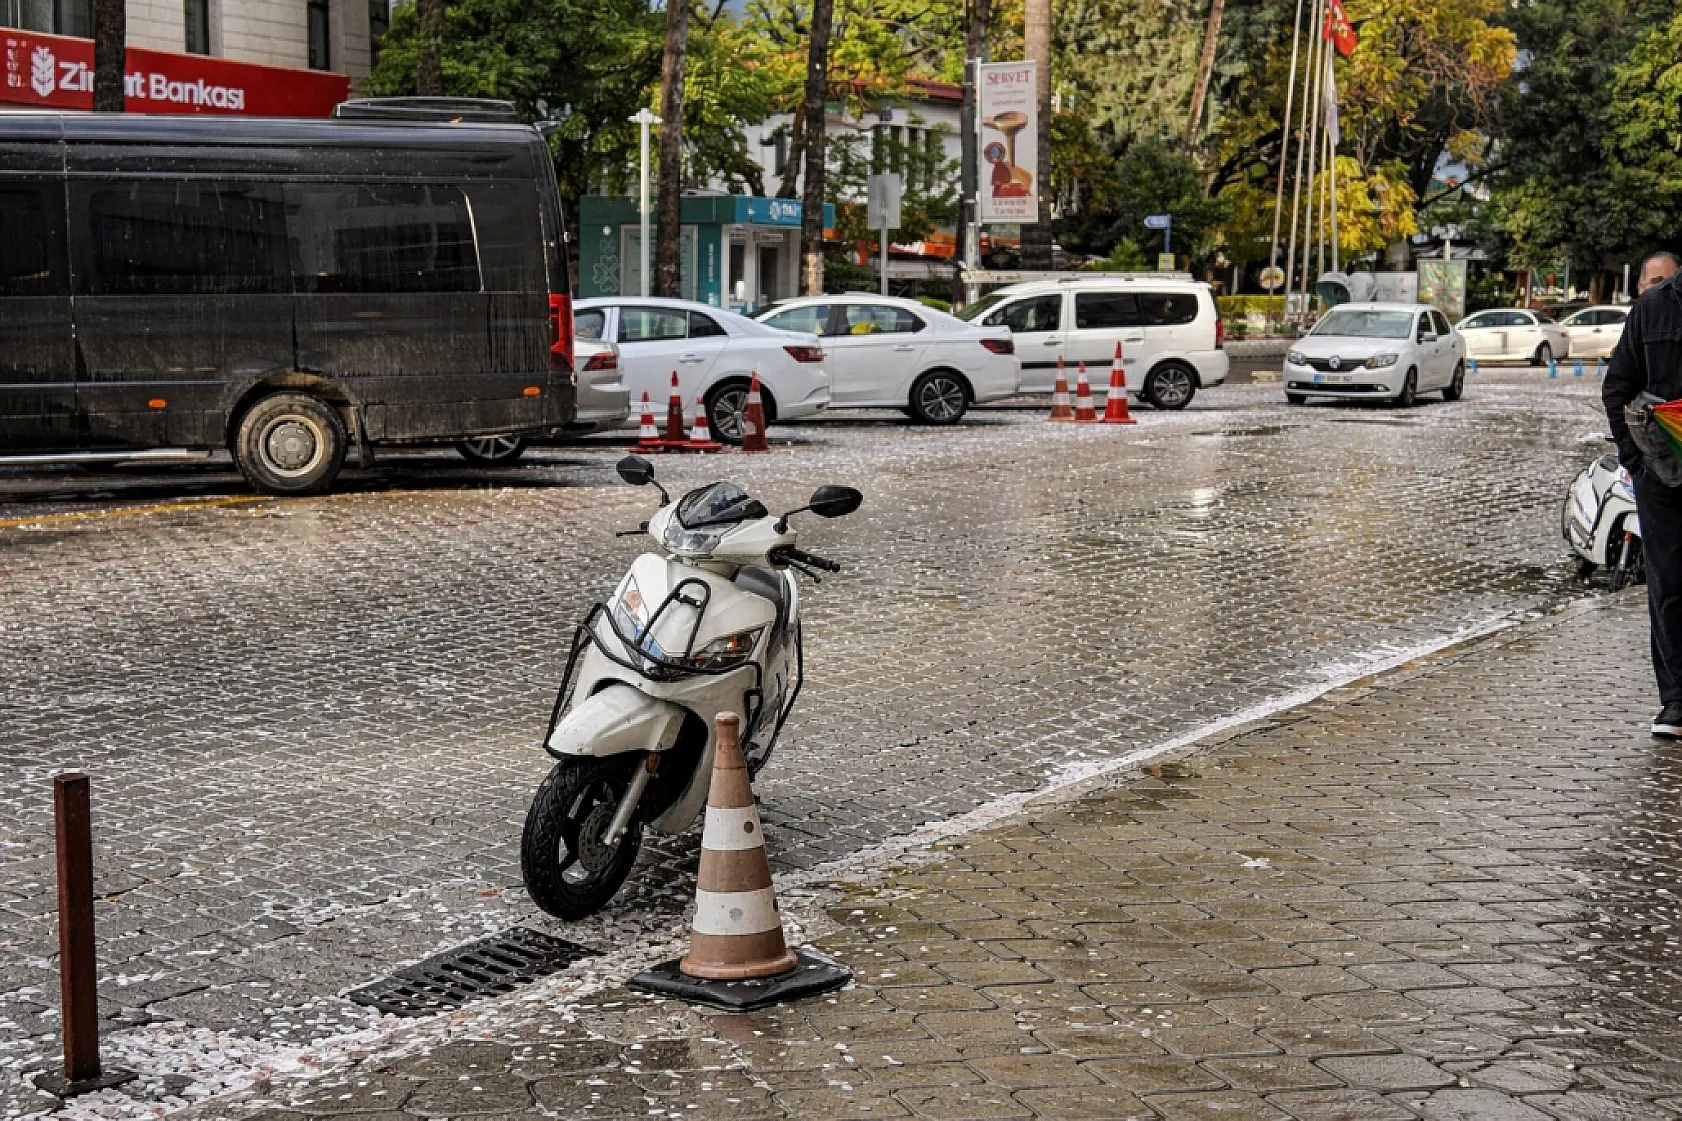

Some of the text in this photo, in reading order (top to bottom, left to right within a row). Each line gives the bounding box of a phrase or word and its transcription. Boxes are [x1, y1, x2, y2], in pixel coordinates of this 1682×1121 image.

[58, 61, 146, 98] Zirat
[149, 72, 245, 110] Bankası
[985, 69, 1032, 86] SERVET
